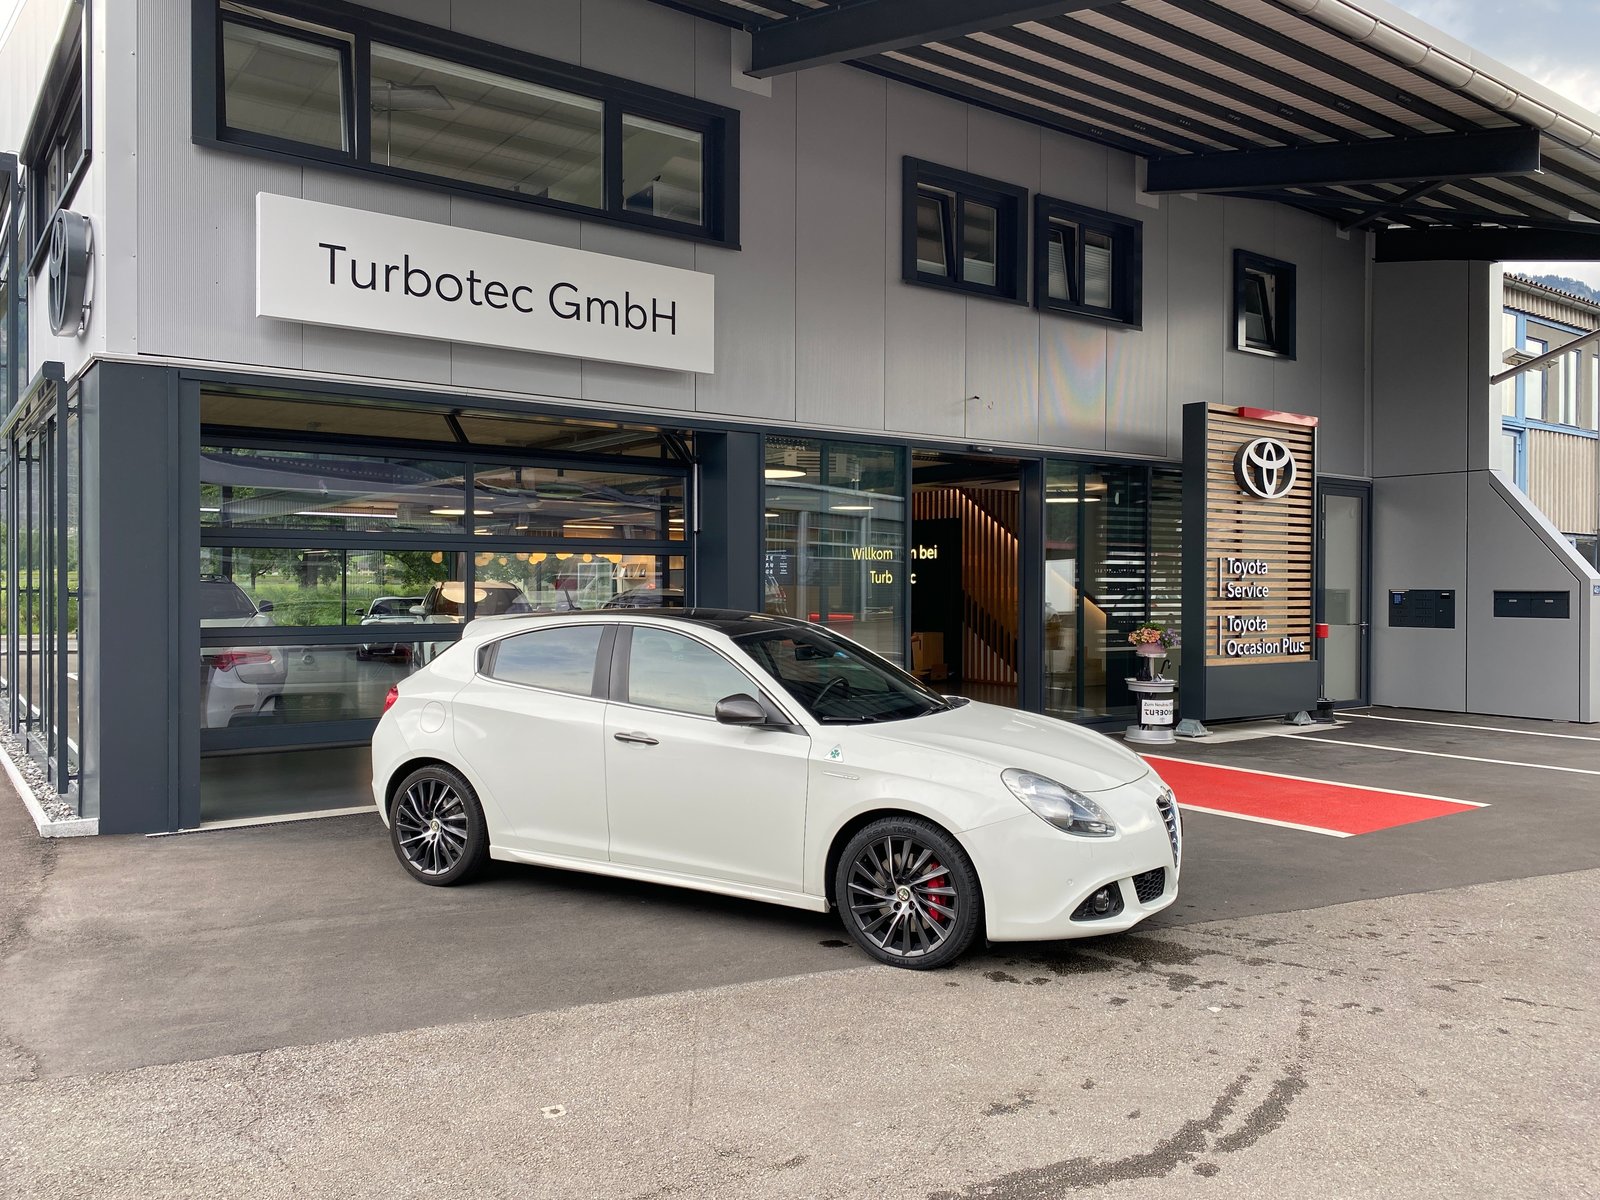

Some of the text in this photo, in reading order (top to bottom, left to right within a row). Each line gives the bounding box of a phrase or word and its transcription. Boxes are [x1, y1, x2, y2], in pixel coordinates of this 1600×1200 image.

[319, 242, 676, 335] Turbotec GmbH
[919, 544, 938, 559] bei
[1227, 557, 1268, 578] Toyota
[1227, 582, 1269, 598] Service
[1227, 615, 1268, 636] Toyota
[1227, 637, 1305, 655] Occasion Plus
